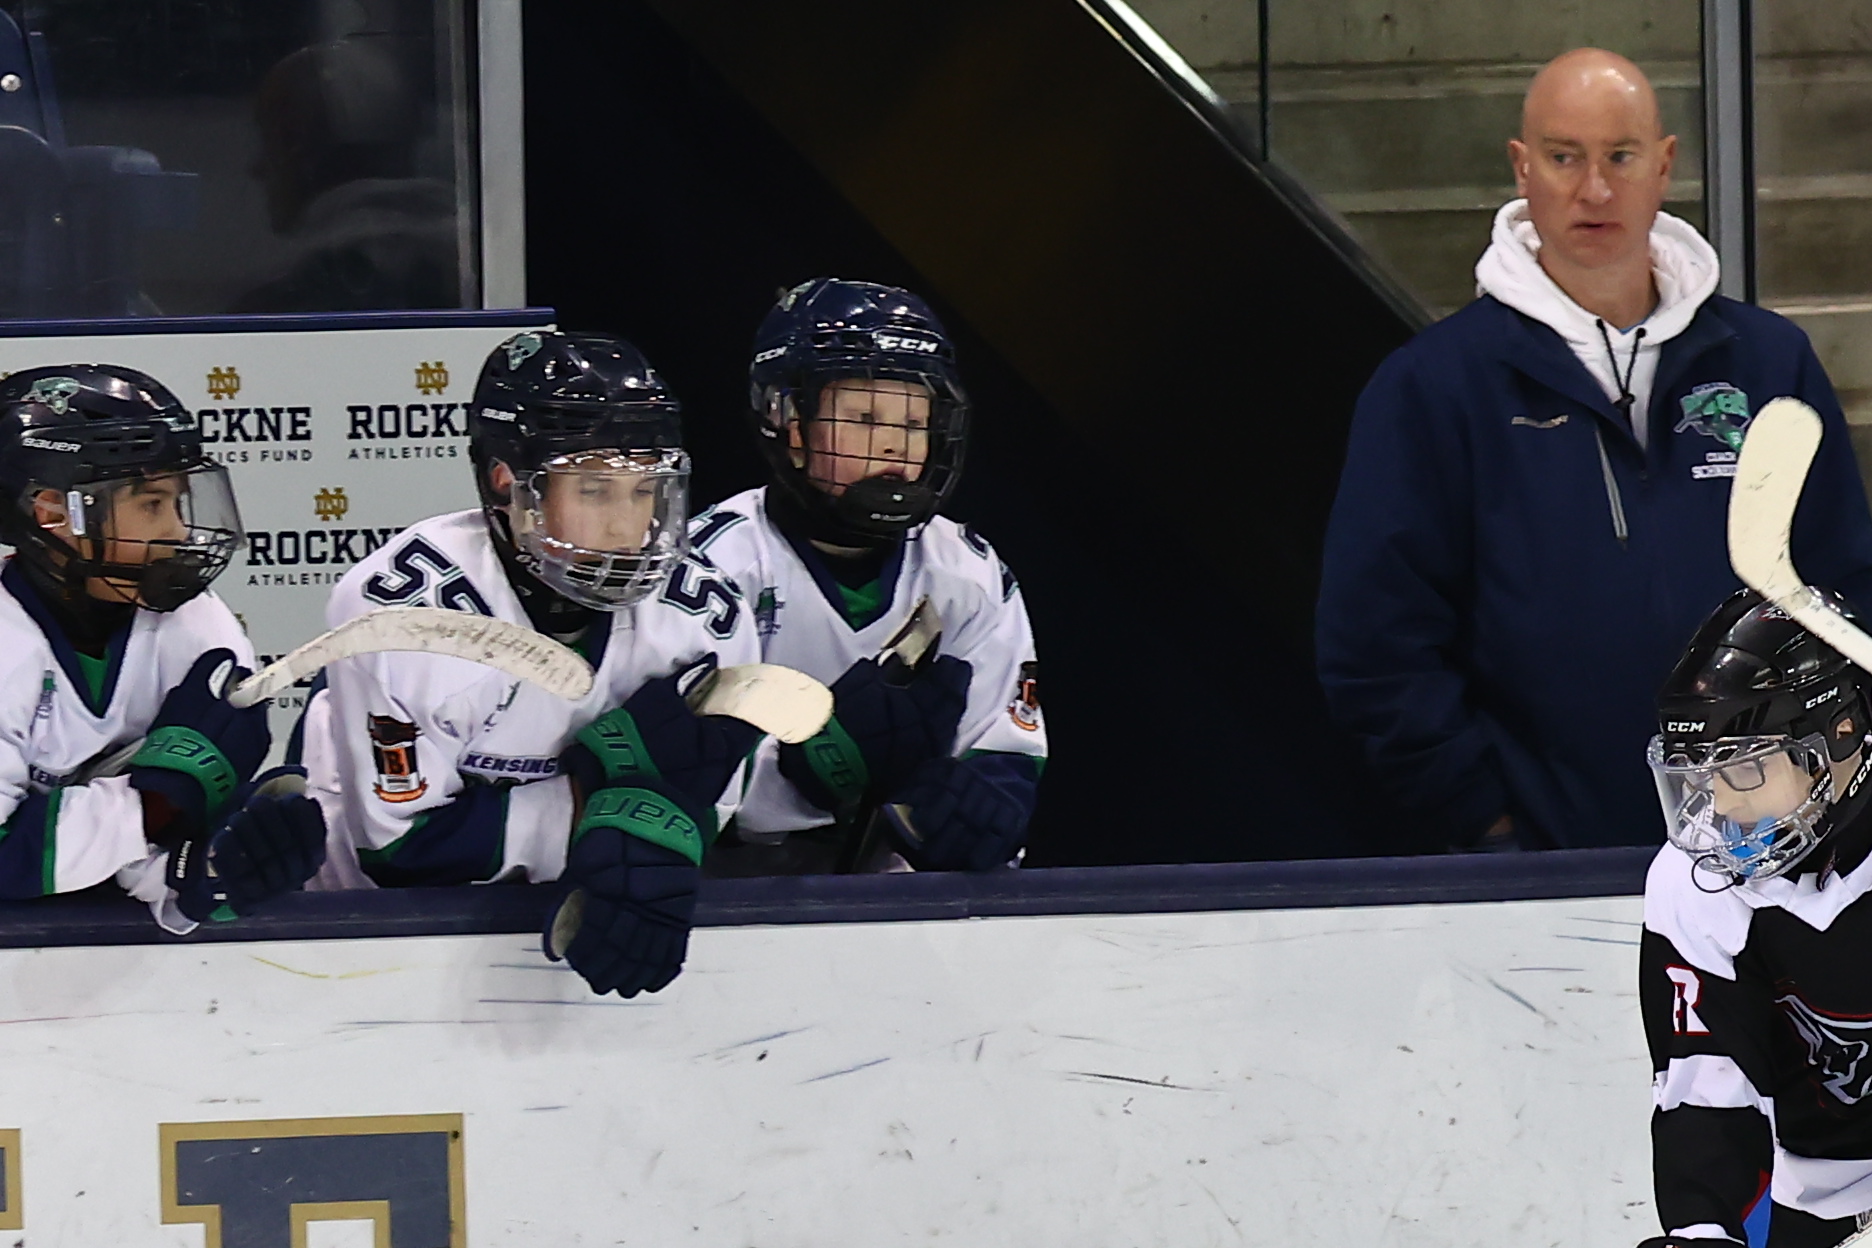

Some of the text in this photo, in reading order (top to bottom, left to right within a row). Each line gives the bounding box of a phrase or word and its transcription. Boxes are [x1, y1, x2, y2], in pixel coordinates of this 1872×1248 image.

[197, 406, 312, 444] CKNE
[346, 402, 472, 440] ROCK
[260, 450, 313, 463] FUND
[348, 445, 459, 461] ATHLETICS
[246, 526, 408, 566] ROCKN
[247, 572, 343, 587] ATHLETI
[1804, 685, 1839, 710] CCM
[1666, 721, 1706, 733] CCM
[462, 752, 557, 774] KENSING
[1810, 772, 1832, 800] CCM
